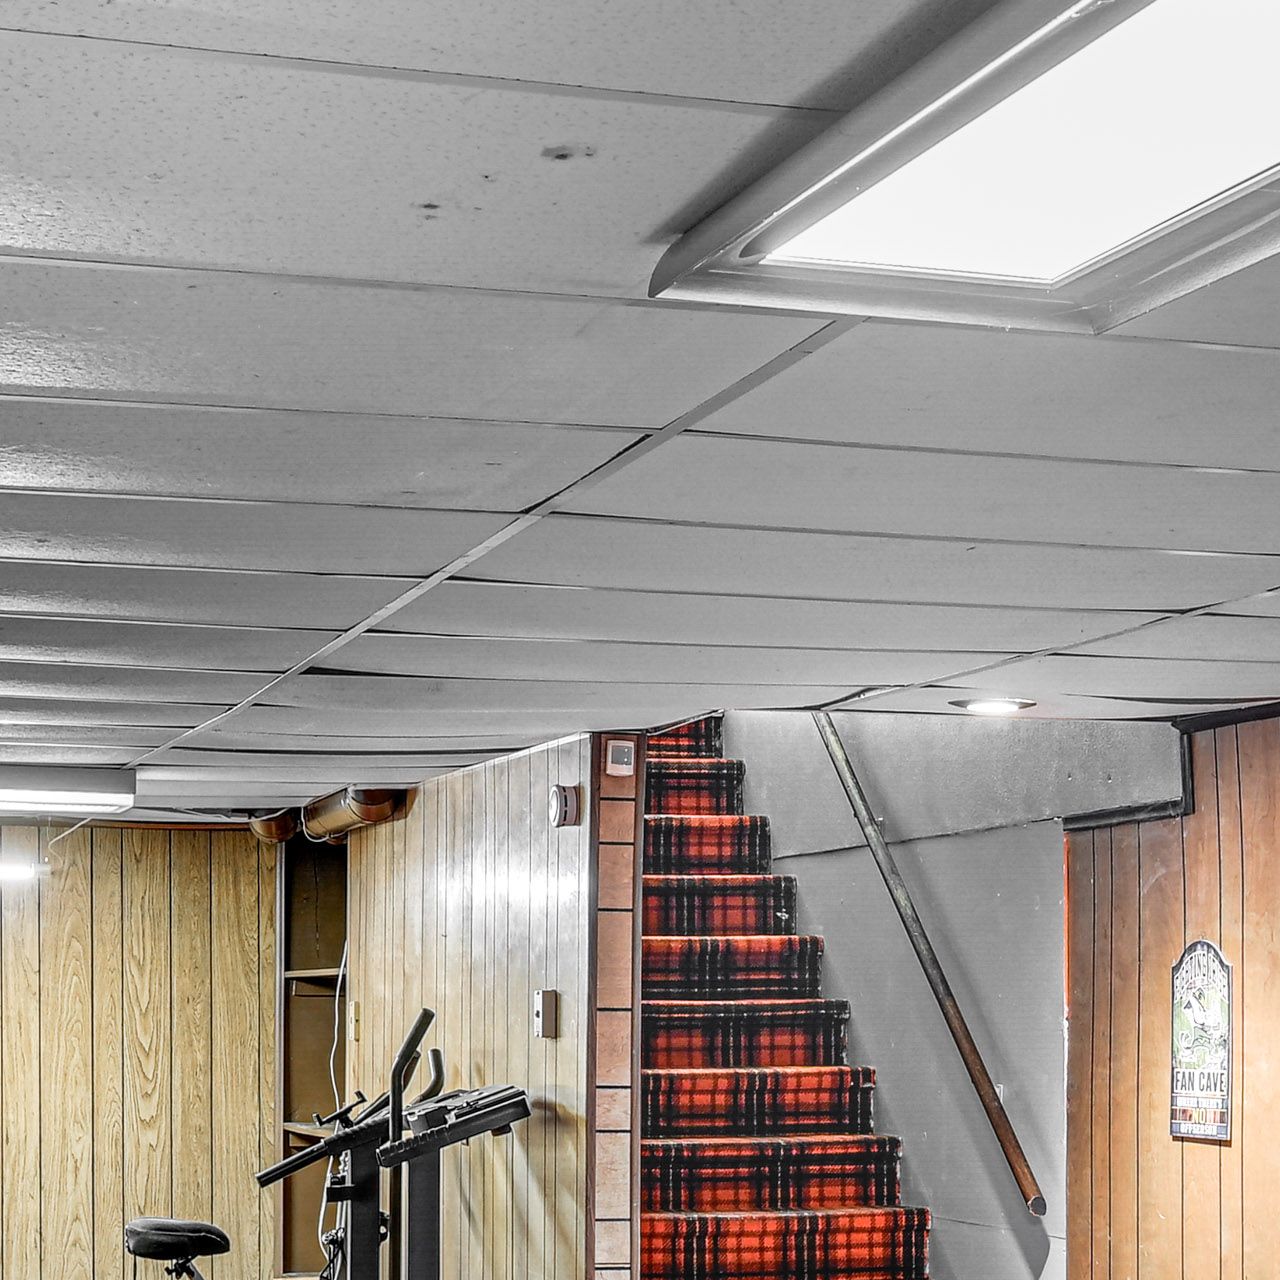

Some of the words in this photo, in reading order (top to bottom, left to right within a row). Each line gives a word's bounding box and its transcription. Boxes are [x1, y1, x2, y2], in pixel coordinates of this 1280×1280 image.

[1175, 1071, 1195, 1091] FAN
[1199, 1072, 1225, 1092] CAVE
[1192, 1108, 1207, 1124] NO
